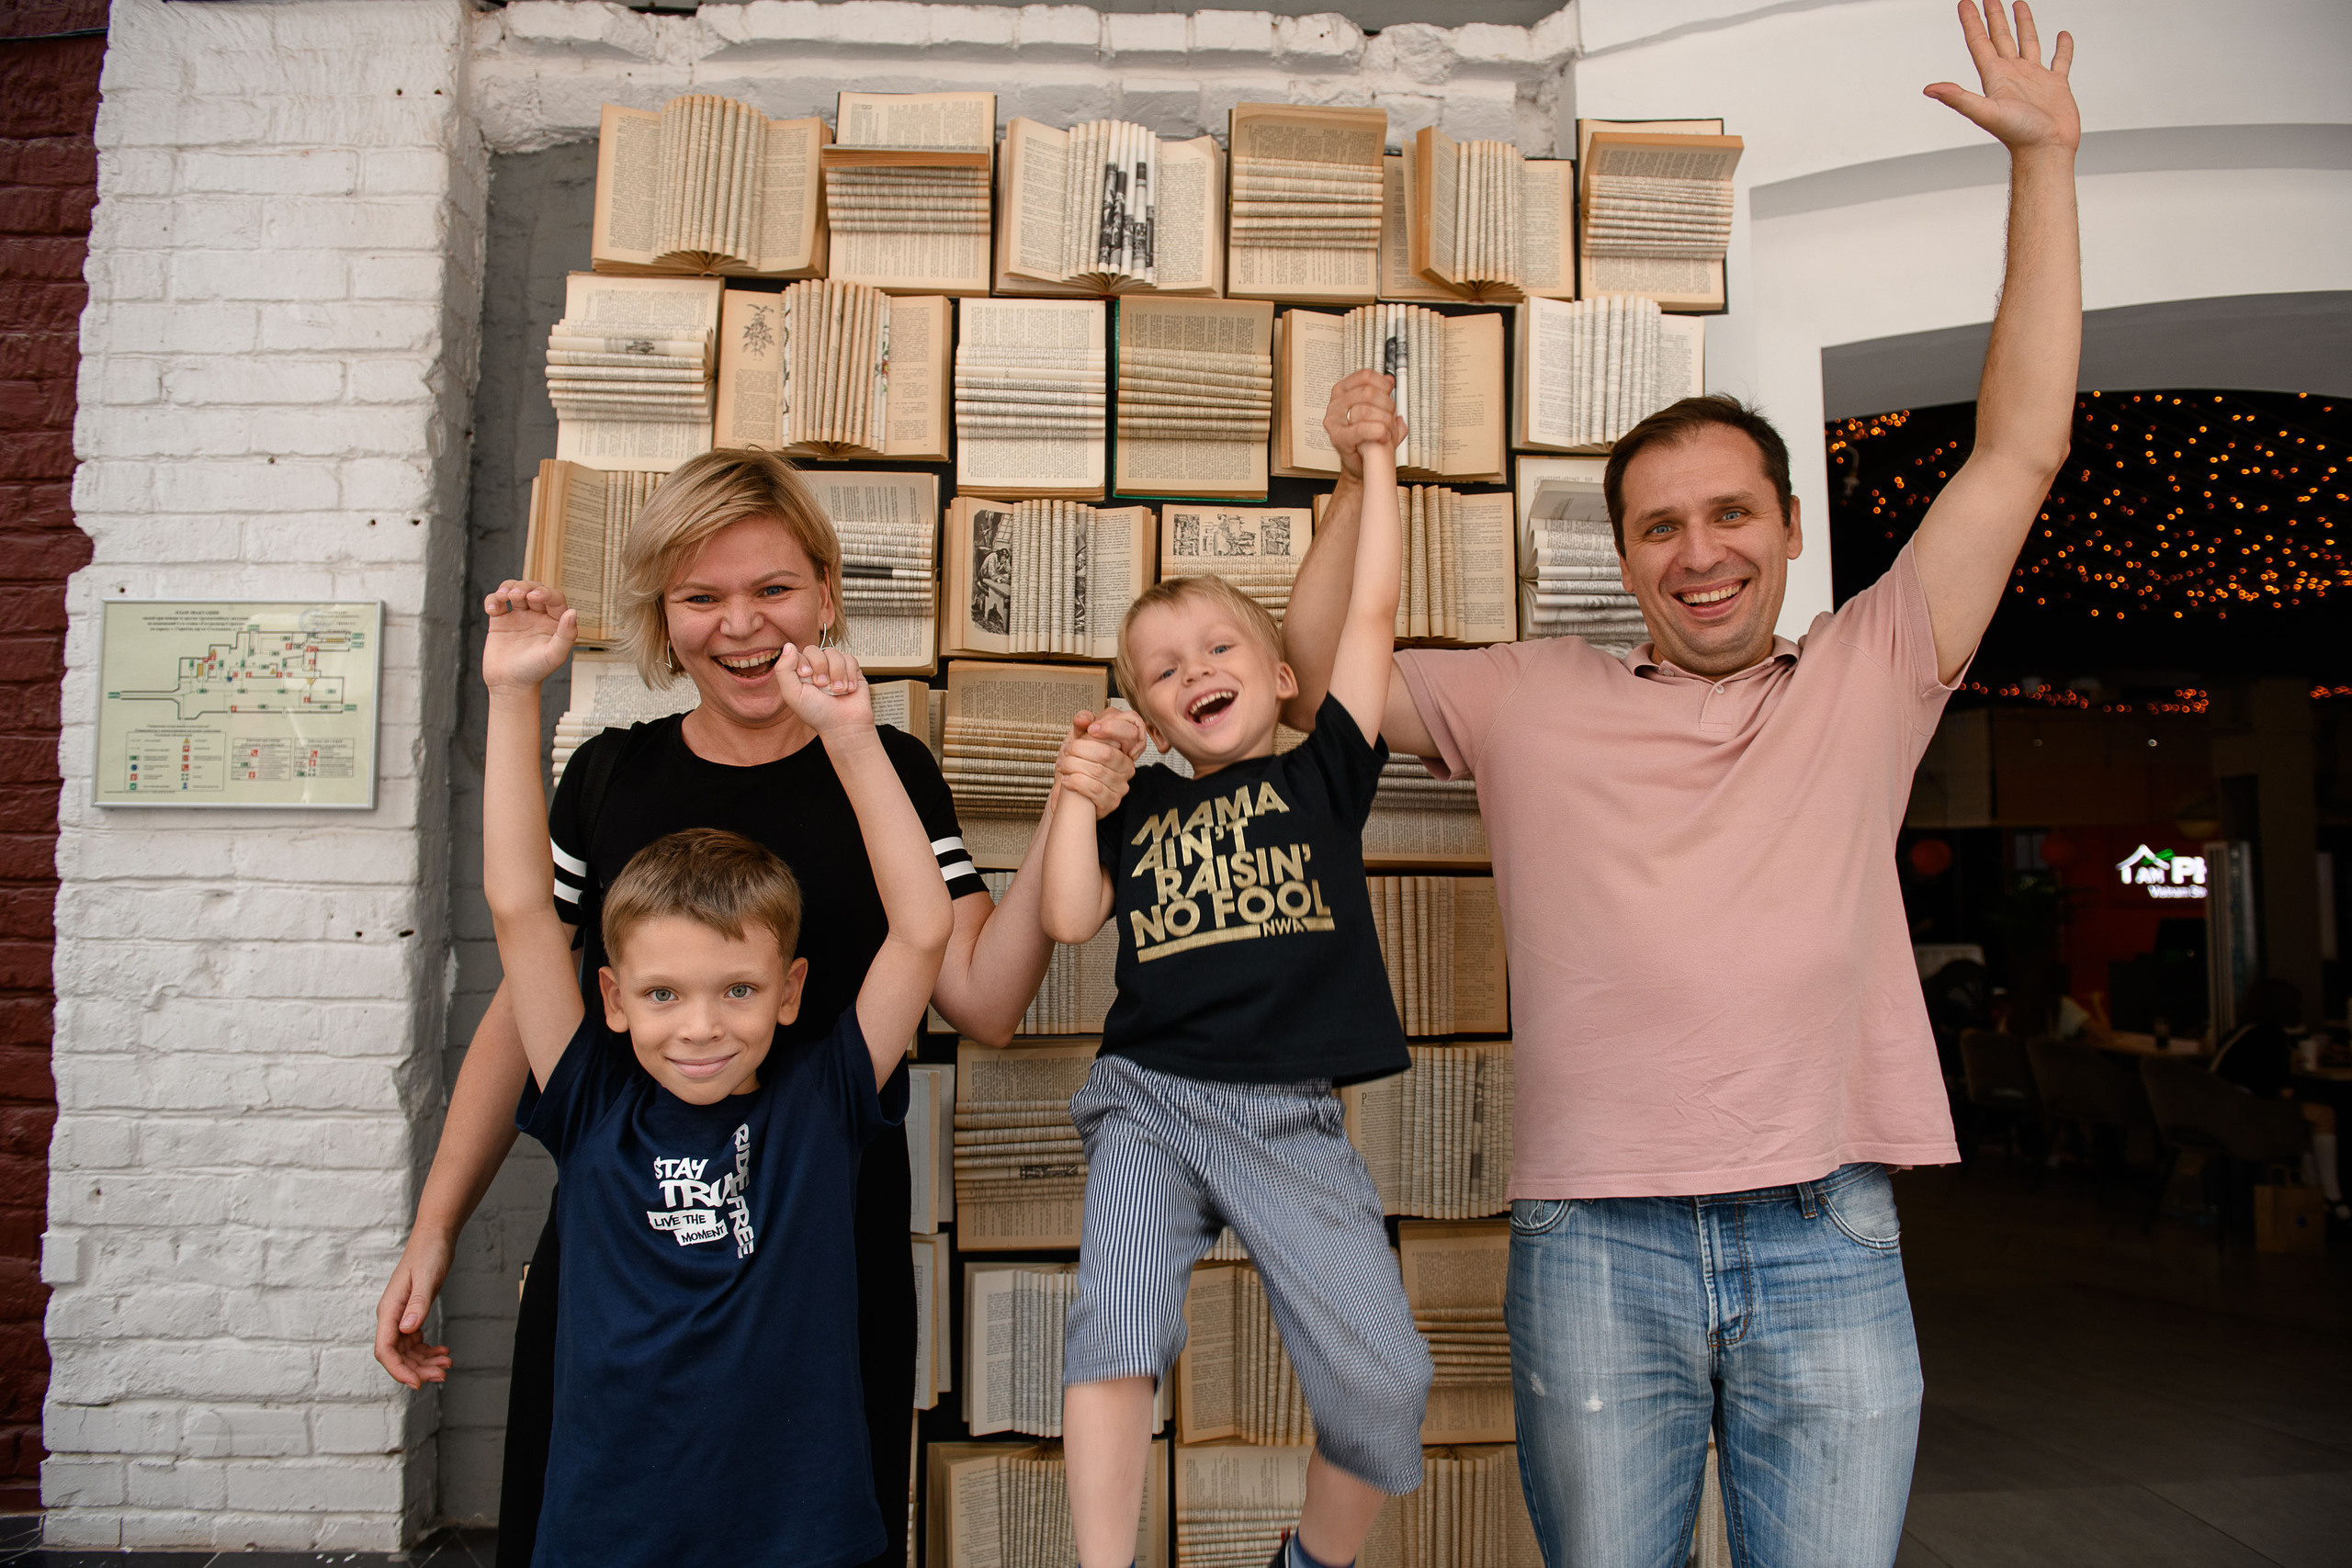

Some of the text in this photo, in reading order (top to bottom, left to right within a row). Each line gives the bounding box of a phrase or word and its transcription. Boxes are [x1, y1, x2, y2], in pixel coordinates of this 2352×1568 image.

[1131, 782, 1290, 846] MAMA
[1131, 817, 1249, 878] AIN'T
[1154, 843, 1311, 905] RAISIN'
[1130, 879, 1331, 948] NO FOOL
[1262, 918, 1305, 938] NWA
[653, 1156, 709, 1179] STAY
[659, 1171, 733, 1208] TRU
[729, 1122, 751, 1196] RIDE
[654, 1213, 707, 1227] LIVE THE
[681, 1225, 726, 1243] MOMENT
[726, 1195, 754, 1259] FREE
